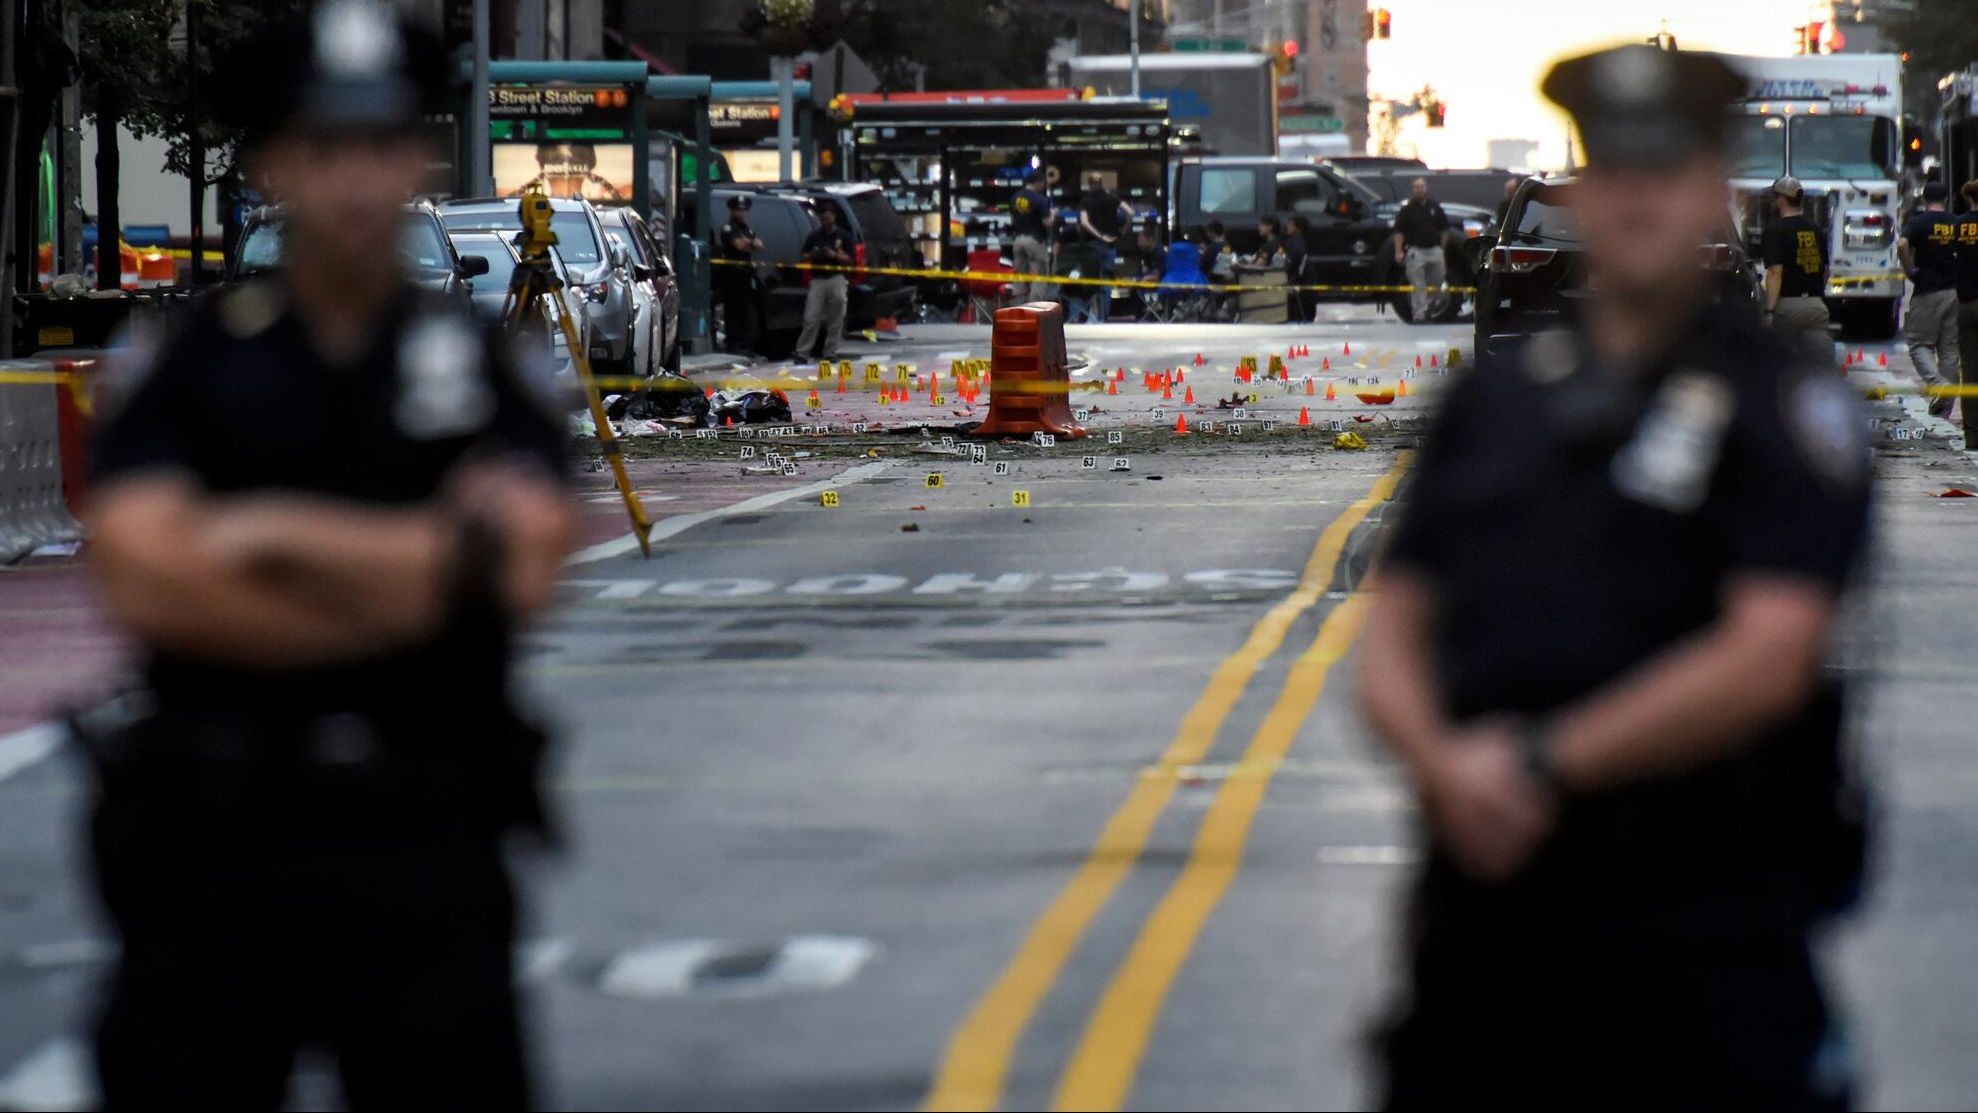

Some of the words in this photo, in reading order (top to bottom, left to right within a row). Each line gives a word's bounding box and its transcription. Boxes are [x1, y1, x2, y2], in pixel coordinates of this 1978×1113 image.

[499, 90, 541, 104] Street
[545, 89, 594, 104] Station
[530, 105, 537, 114] &
[541, 104, 582, 116] Brooklyn
[727, 105, 770, 120] Station
[1933, 223, 1954, 236] FBI
[1960, 223, 1978, 236] FB
[896, 365, 907, 379] 71
[1077, 411, 1087, 420] 37
[1154, 410, 1164, 419] 39
[1234, 409, 1245, 418] 38
[1200, 422, 1211, 432] 83
[1043, 436, 1053, 446] 76
[1109, 434, 1120, 443] 85
[742, 446, 752, 457] 74
[958, 444, 967, 454] 72
[973, 454, 984, 464] 64
[1083, 457, 1094, 467] 63
[784, 463, 795, 474] 65
[995, 462, 1007, 473] 61
[928, 475, 940, 487] 60
[824, 492, 837, 505] 32
[1015, 491, 1027, 504] 31
[553, 566, 1297, 600] SCHOOL
